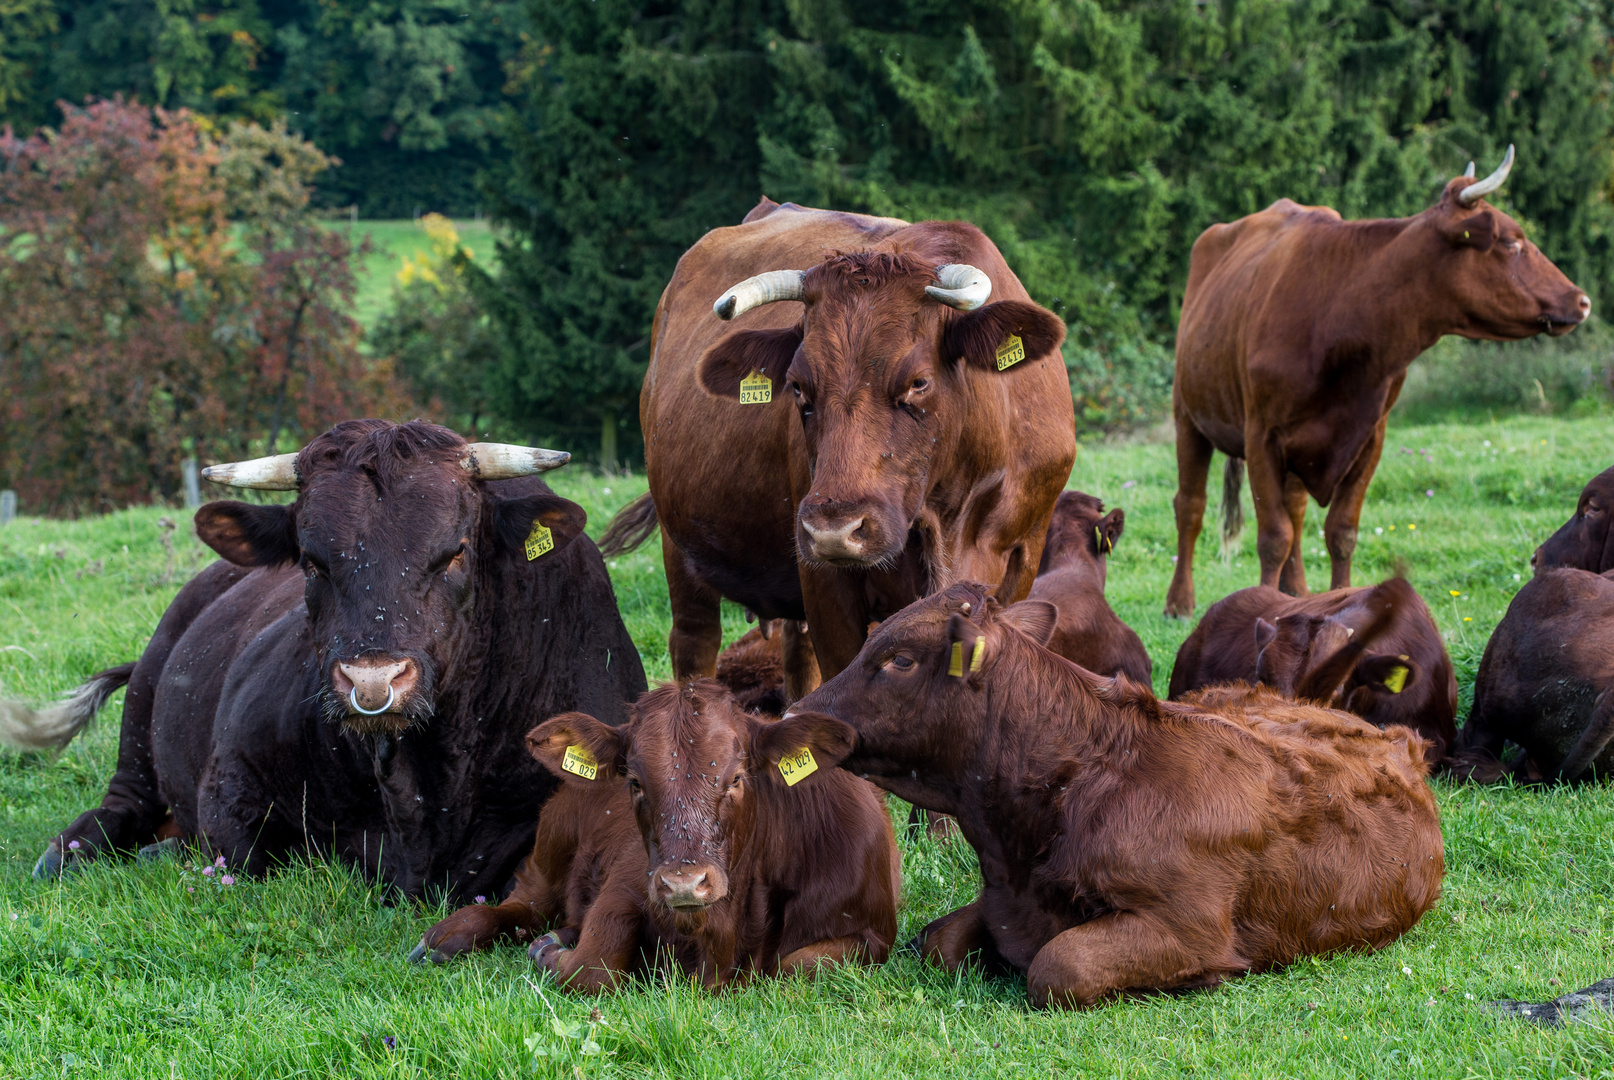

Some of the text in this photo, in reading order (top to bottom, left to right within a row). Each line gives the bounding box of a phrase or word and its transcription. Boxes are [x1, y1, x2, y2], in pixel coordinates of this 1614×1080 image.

[997, 348, 1023, 369] 82419
[740, 390, 771, 403] 82419
[527, 538, 552, 559] 85 345
[563, 757, 596, 778] 42 029
[780, 750, 811, 776] 42 029
